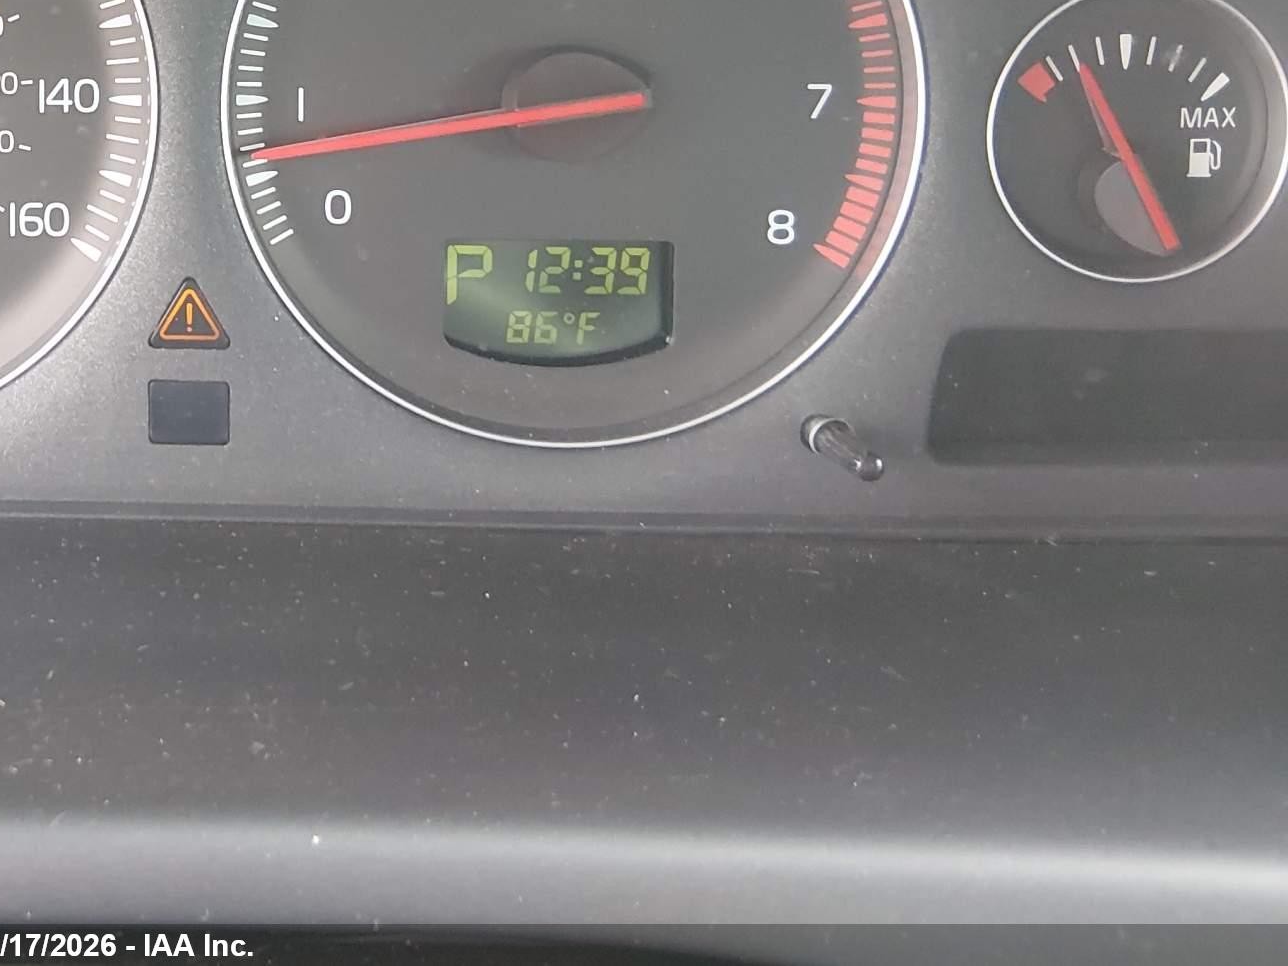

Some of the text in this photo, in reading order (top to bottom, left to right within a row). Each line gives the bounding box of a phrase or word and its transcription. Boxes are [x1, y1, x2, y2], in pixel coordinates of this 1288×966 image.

[37, 78, 99, 114] 140
[298, 87, 304, 122] 1
[807, 83, 832, 119] 7
[1181, 106, 1236, 128] MAX
[8, 201, 70, 237] 160
[324, 189, 352, 224] 0
[766, 209, 795, 244] 8
[446, 244, 650, 304] P 12:39
